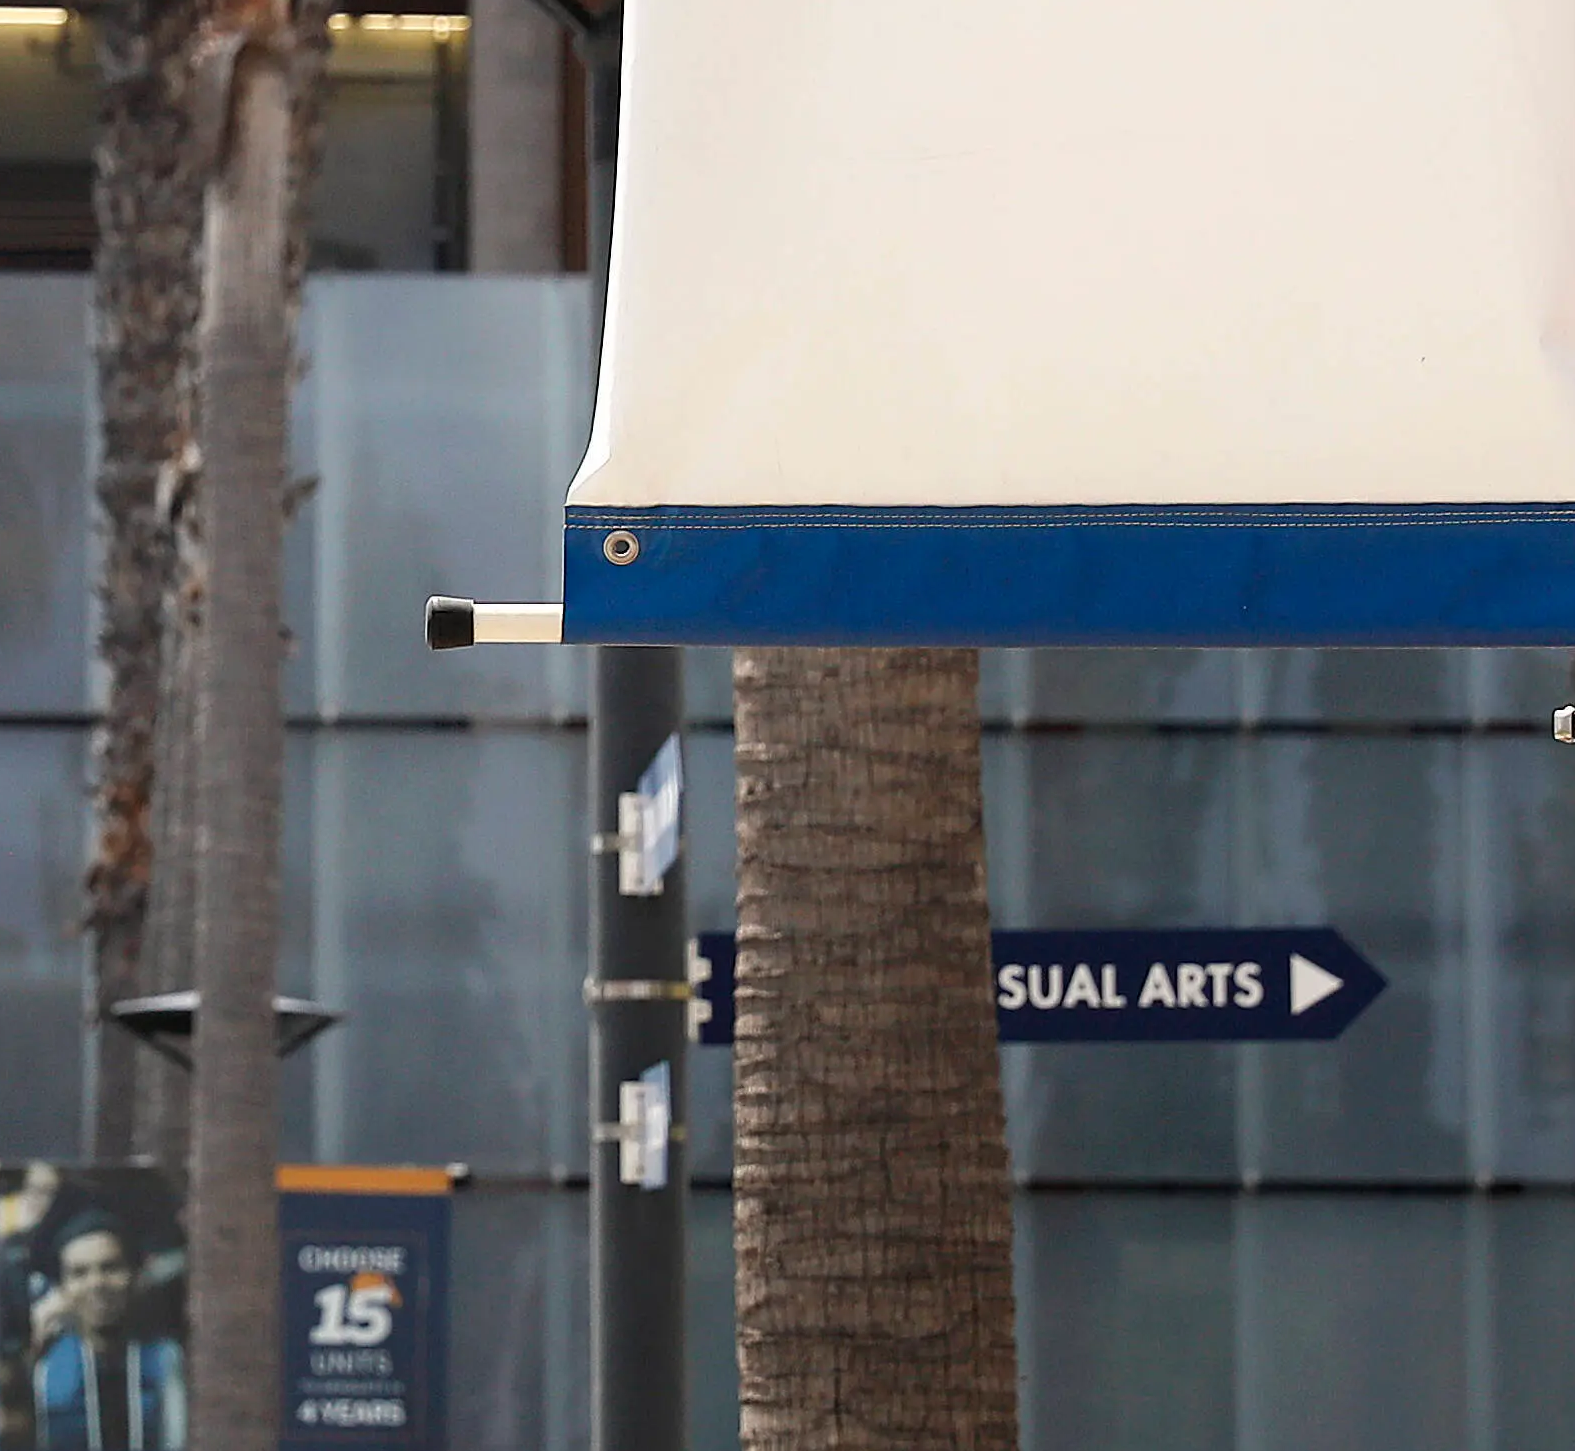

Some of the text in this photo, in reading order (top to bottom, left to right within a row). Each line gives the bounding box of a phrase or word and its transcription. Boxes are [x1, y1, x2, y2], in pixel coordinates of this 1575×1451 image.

[997, 960, 1265, 1011] SUAL ARTS
[298, 1245, 407, 1273] CHOOSE
[309, 1283, 393, 1346] 15
[322, 1398, 407, 1426] YEARS
